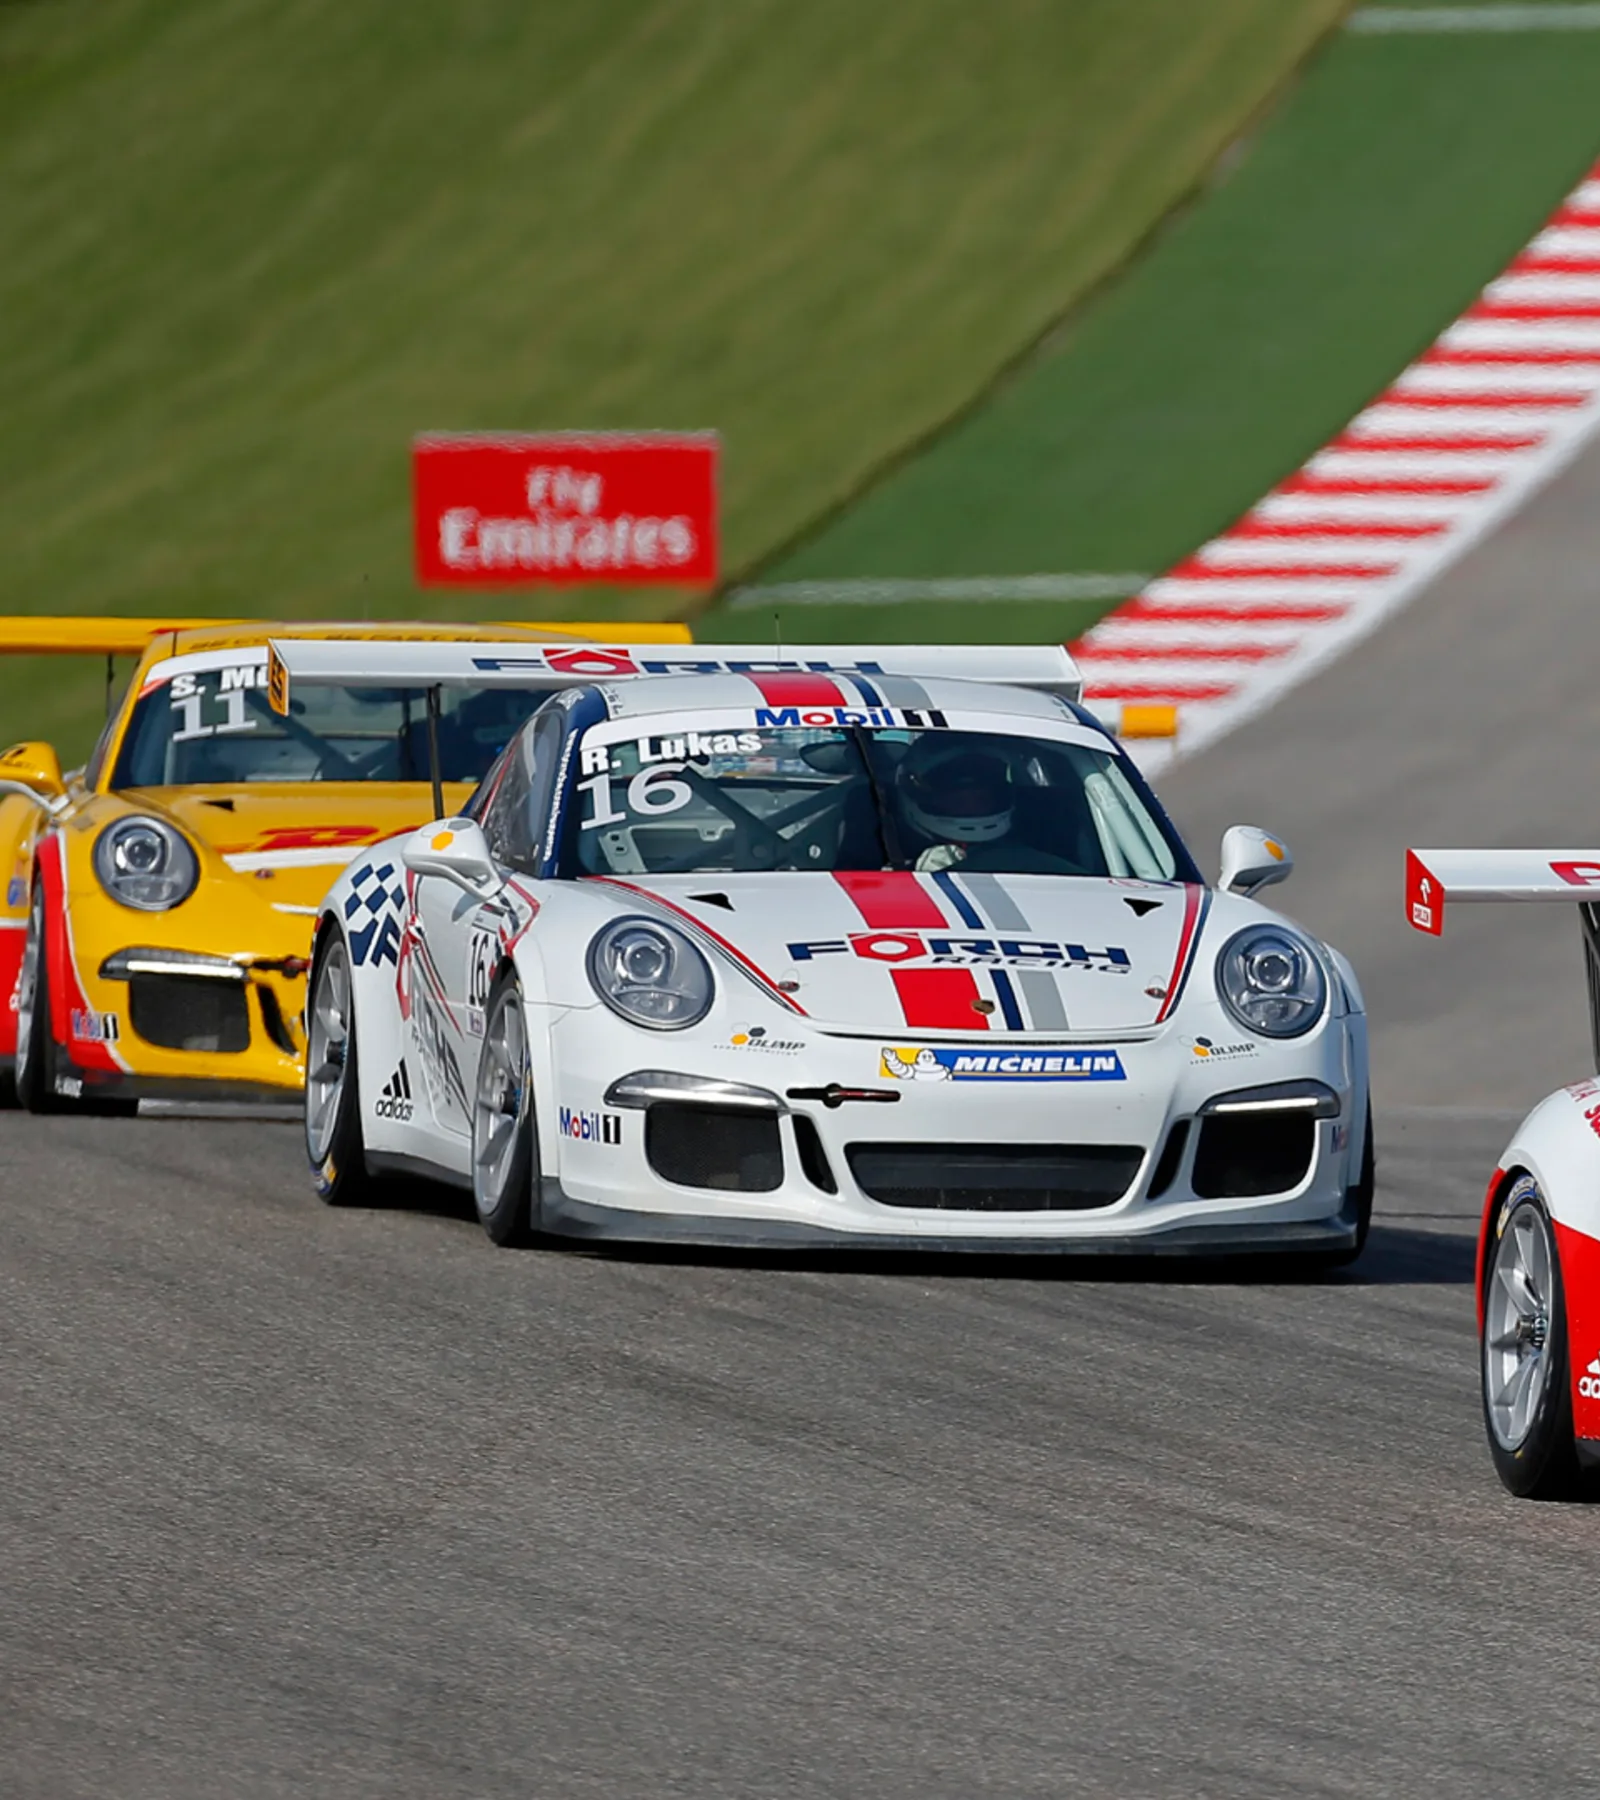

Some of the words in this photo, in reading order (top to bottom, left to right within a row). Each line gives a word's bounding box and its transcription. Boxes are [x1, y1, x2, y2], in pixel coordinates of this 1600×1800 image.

[526, 464, 601, 514] Fly
[439, 506, 696, 569] Emirates
[170, 673, 207, 699] S.
[170, 688, 257, 742] 11
[755, 708, 896, 727] Mobil
[581, 746, 621, 776] R.
[638, 731, 763, 763] Lukas
[576, 762, 693, 830] 16
[469, 932, 488, 1007] 16
[931, 956, 1132, 975] RACING
[748, 1038, 806, 1050] OLIMP
[1209, 1043, 1255, 1056] OLIMP
[954, 1056, 1117, 1073] MICHELIN
[375, 1098, 414, 1121] adidas
[560, 1106, 600, 1142] Mobil
